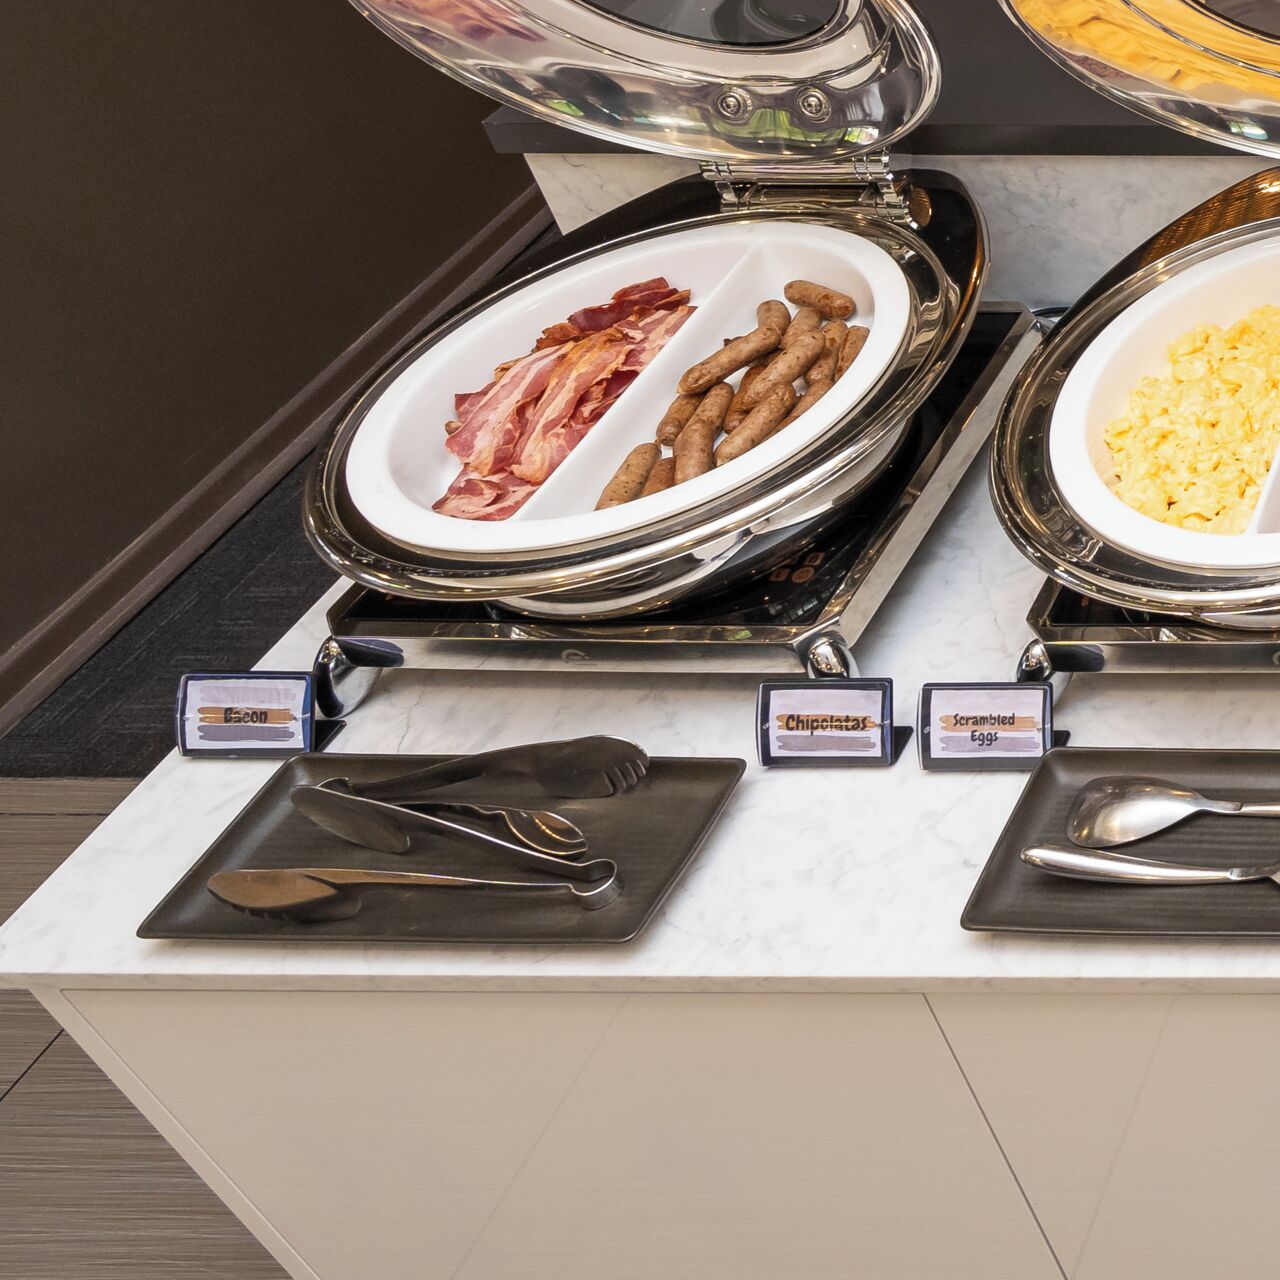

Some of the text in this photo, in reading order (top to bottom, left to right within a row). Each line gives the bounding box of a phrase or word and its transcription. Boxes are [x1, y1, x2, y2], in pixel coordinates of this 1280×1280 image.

[223, 706, 269, 725] Bacon
[952, 712, 1016, 729] Scrambled
[785, 714, 868, 737] Chipolatas
[970, 730, 999, 747] Eggs
